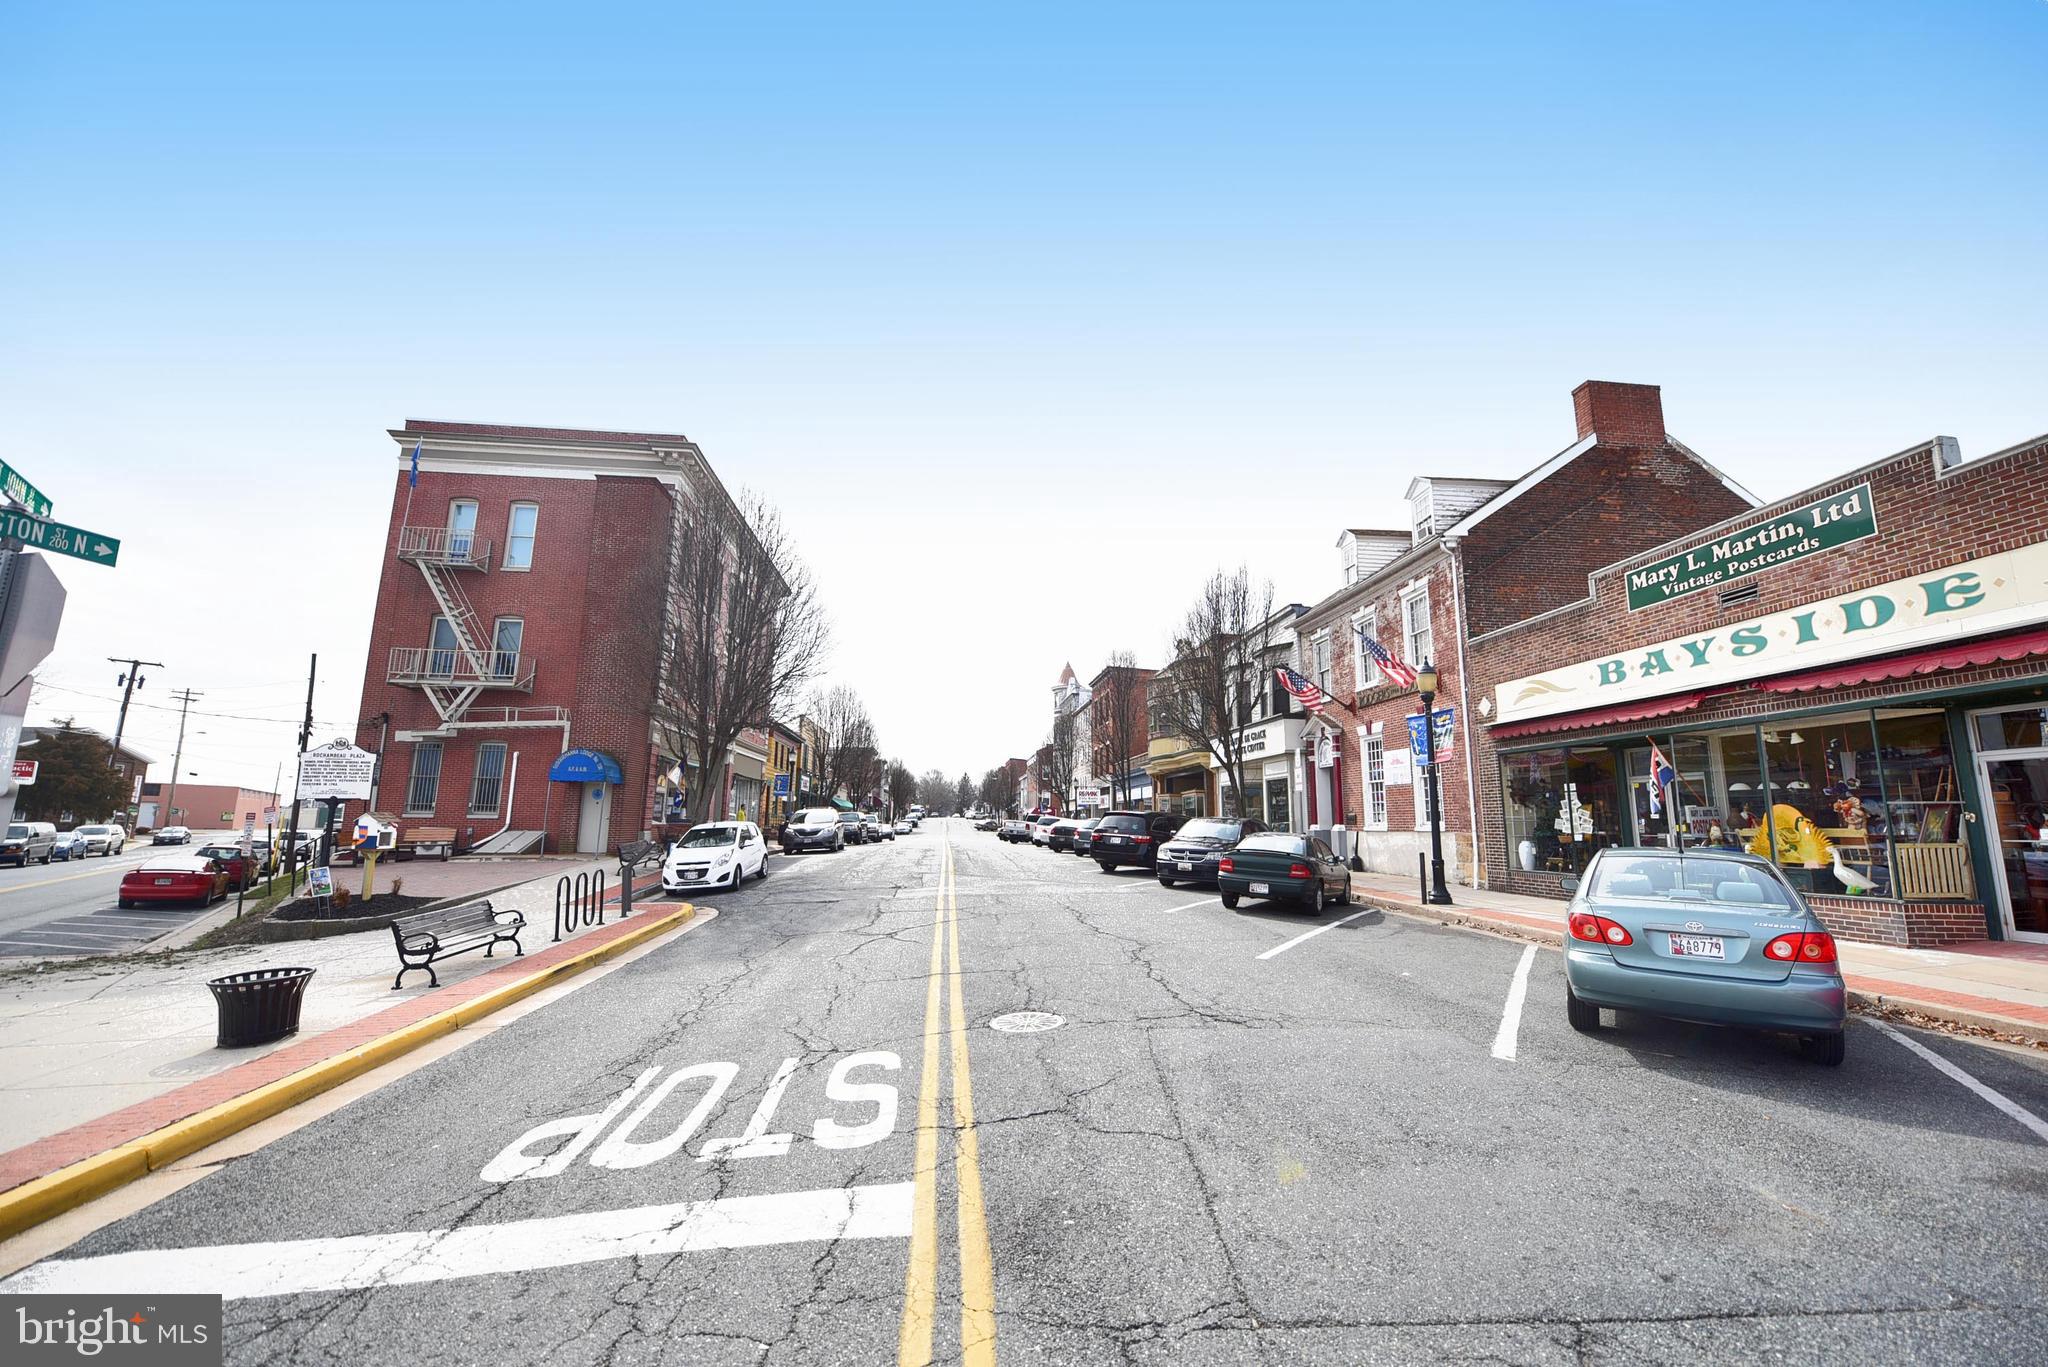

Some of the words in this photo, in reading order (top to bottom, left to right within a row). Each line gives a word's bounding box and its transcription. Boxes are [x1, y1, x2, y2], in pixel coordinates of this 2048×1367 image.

[49, 536, 69, 551] 200
[55, 527, 68, 539] ST
[1631, 561, 1681, 592] Mary
[1686, 553, 1707, 571] L.
[1711, 520, 1805, 564] Martin,
[1811, 493, 1862, 529] Ltd
[1660, 569, 1723, 597] Vintage
[1727, 536, 1820, 576] Postcards
[1598, 571, 1986, 687] BAYSIDE
[479, 1050, 901, 1183] STOP
